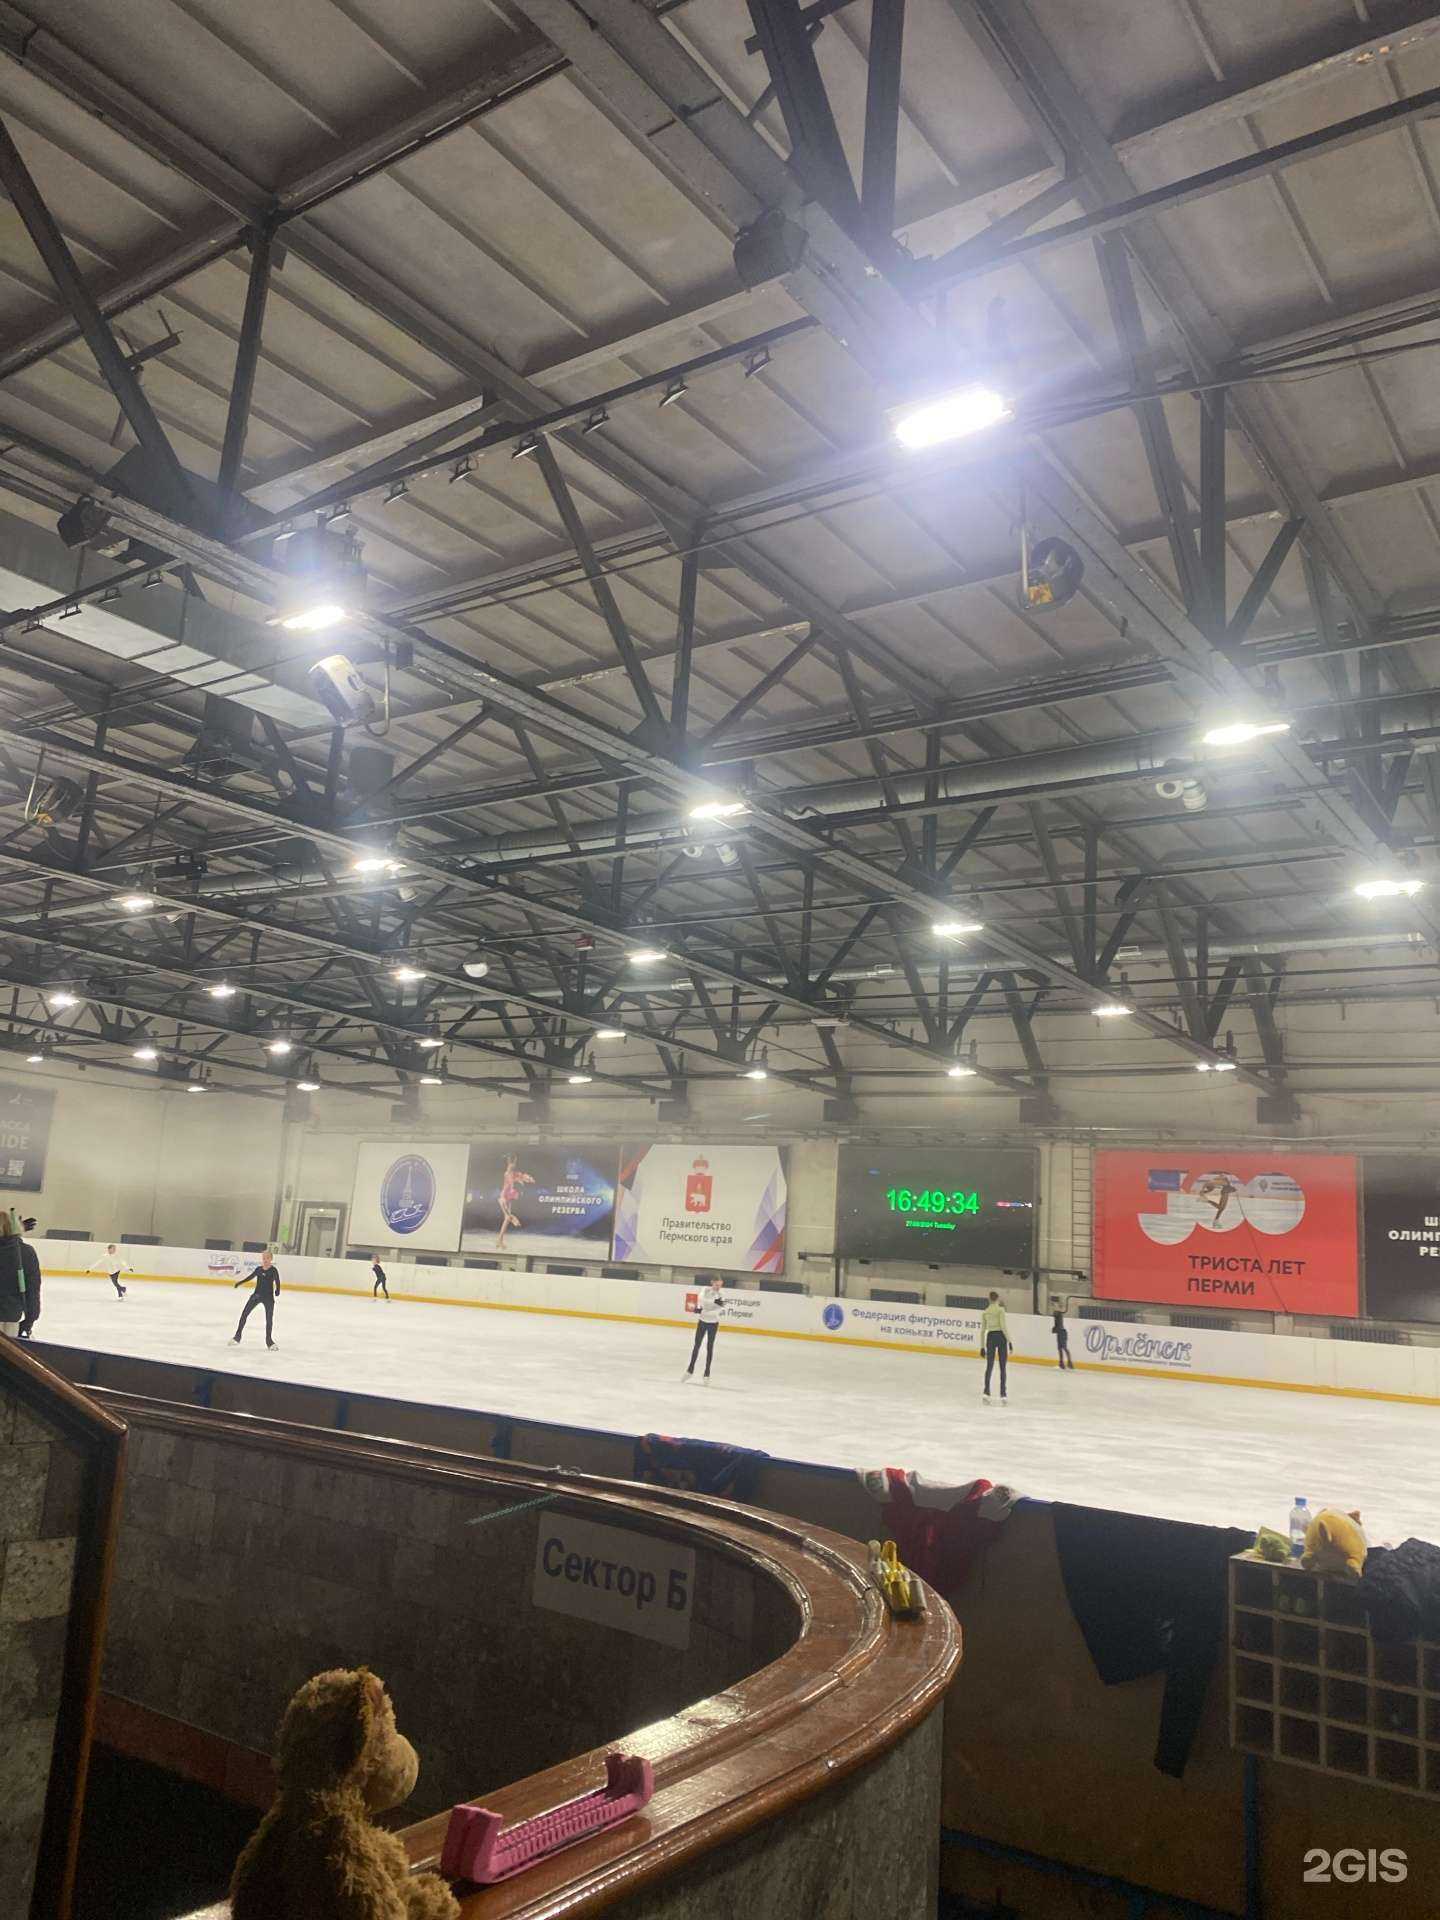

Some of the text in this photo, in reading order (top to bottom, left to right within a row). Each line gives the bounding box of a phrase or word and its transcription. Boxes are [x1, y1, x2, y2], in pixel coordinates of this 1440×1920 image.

[538, 1196, 602, 1205] ОЛИМПИЙСКОГО
[887, 1189, 979, 1215] 16:49:34
[551, 1206, 586, 1215] РЕЗЕРВА
[662, 1217, 732, 1231] Правительство
[1424, 1216, 1440, 1227] Ш
[660, 1230, 733, 1246] Пермского края
[1187, 1255, 1306, 1275] ТРИСТА ЛЕТ
[1187, 1278, 1256, 1296] ПЕРМИ
[851, 1308, 982, 1329] Федерация фигурного кат
[880, 1325, 974, 1342] на коньках России
[543, 1537, 688, 1612] Сектор Б
